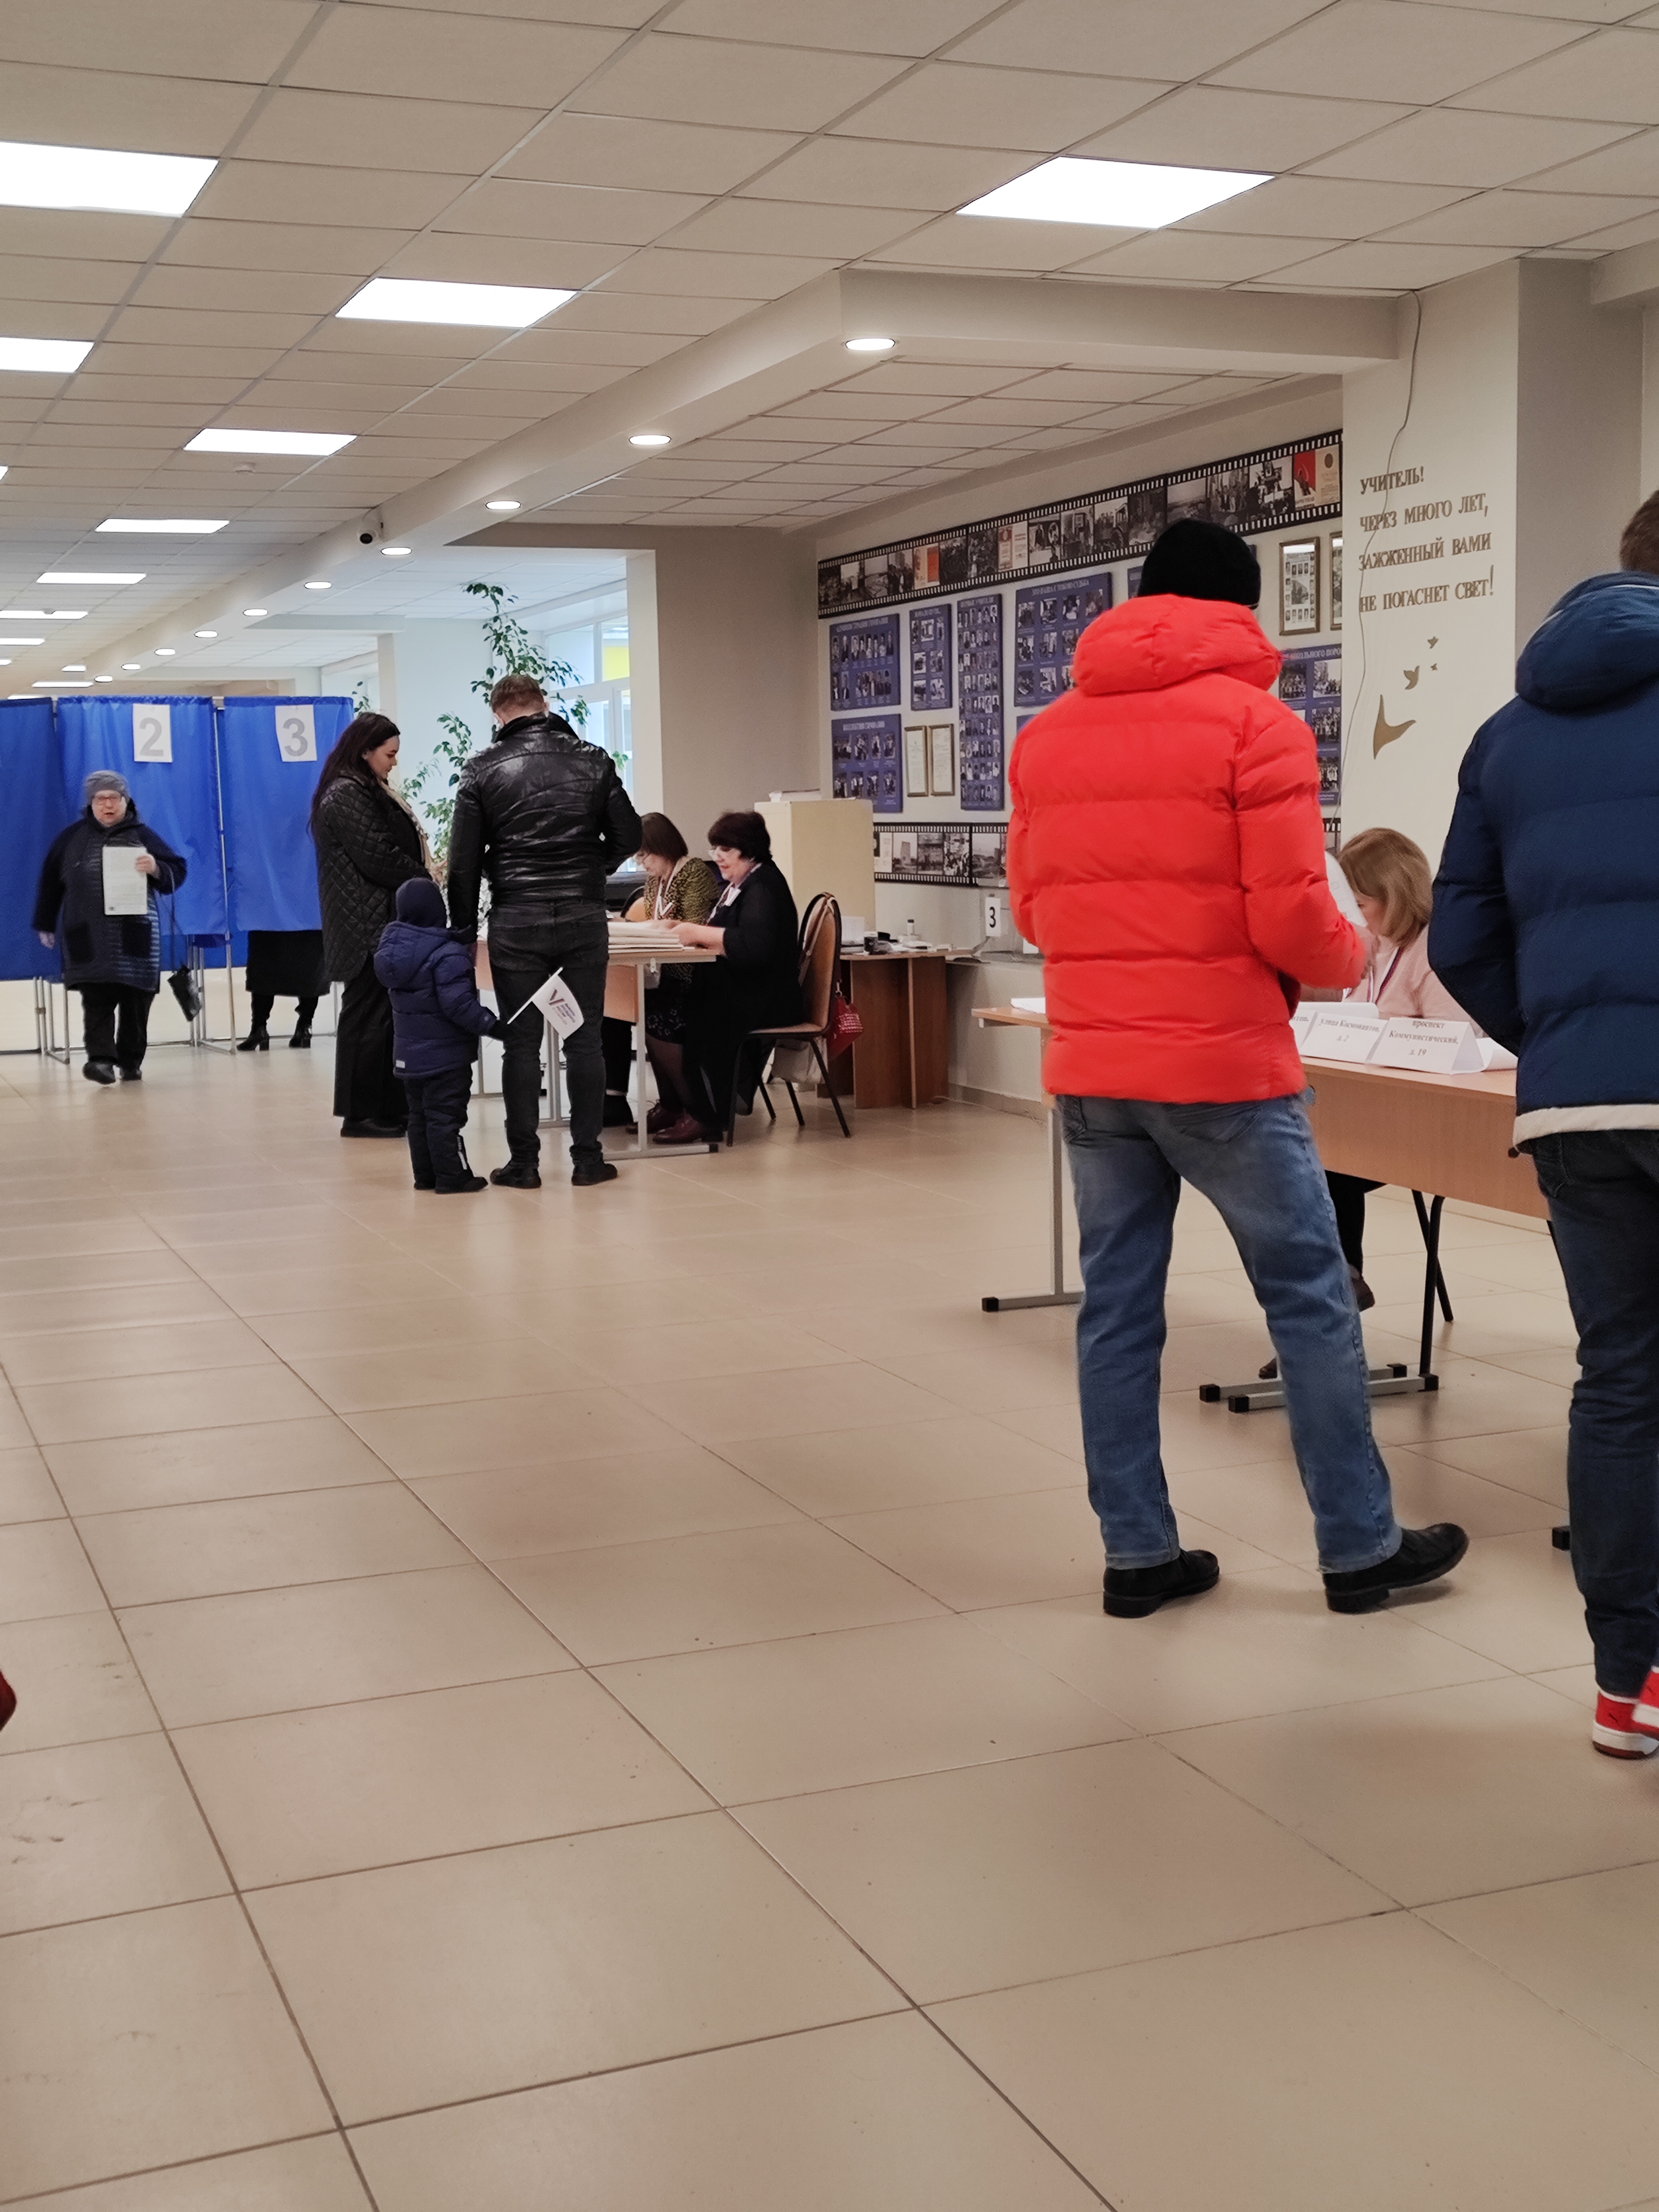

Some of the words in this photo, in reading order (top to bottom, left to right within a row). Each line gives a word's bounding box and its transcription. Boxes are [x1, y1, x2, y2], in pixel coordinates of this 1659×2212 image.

[1360, 466, 1424, 495] УЧИТЕЛЬ!
[1359, 511, 1398, 532] ЧЕРЕЗ
[1404, 500, 1453, 525] МНОГО
[1459, 493, 1488, 517] ЛЕТ,
[1359, 536, 1445, 571] ЗАЖЖЕННЫЙ
[1452, 532, 1492, 556] ВАМИ
[1360, 595, 1377, 612] НЕ
[1383, 584, 1450, 610] ПОГАСНЕТ
[1455, 564, 1494, 599] СВЕТ!
[139, 718, 164, 756] 2
[283, 718, 308, 756] 3
[989, 906, 996, 928] 3
[1388, 1030, 1458, 1044] Коммунистический,
[1412, 1020, 1445, 1029] проспект
